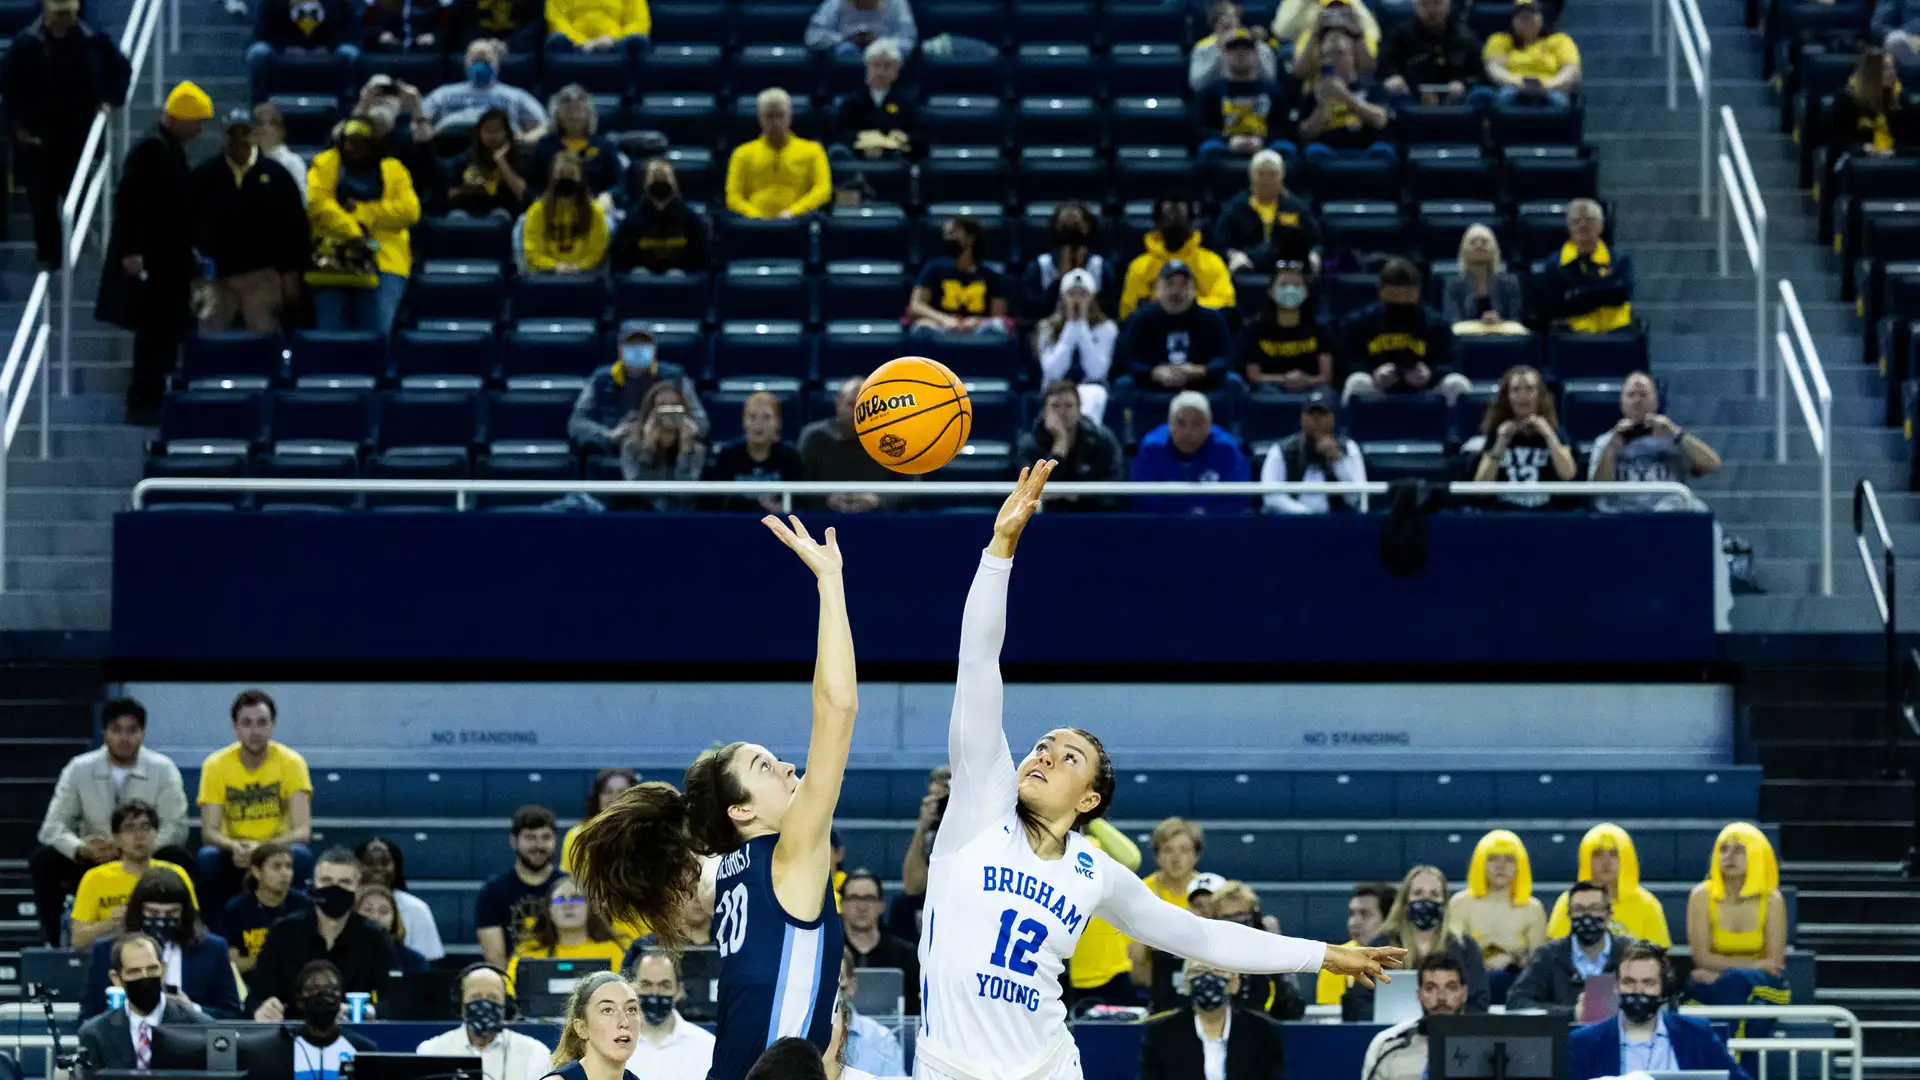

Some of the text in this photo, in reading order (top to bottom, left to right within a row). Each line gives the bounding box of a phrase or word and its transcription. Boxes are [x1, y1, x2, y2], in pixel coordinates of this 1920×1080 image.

[941, 279, 988, 314] M
[856, 393, 916, 425] Wilson
[431, 730, 538, 745] NO STANDING
[1304, 731, 1411, 746] NO STANDING
[1074, 865, 1094, 880] WCC
[983, 866, 1083, 935] BRIGHAM
[716, 882, 748, 958] 20
[990, 908, 1049, 977] 12
[976, 972, 1040, 1012] YOUNG
